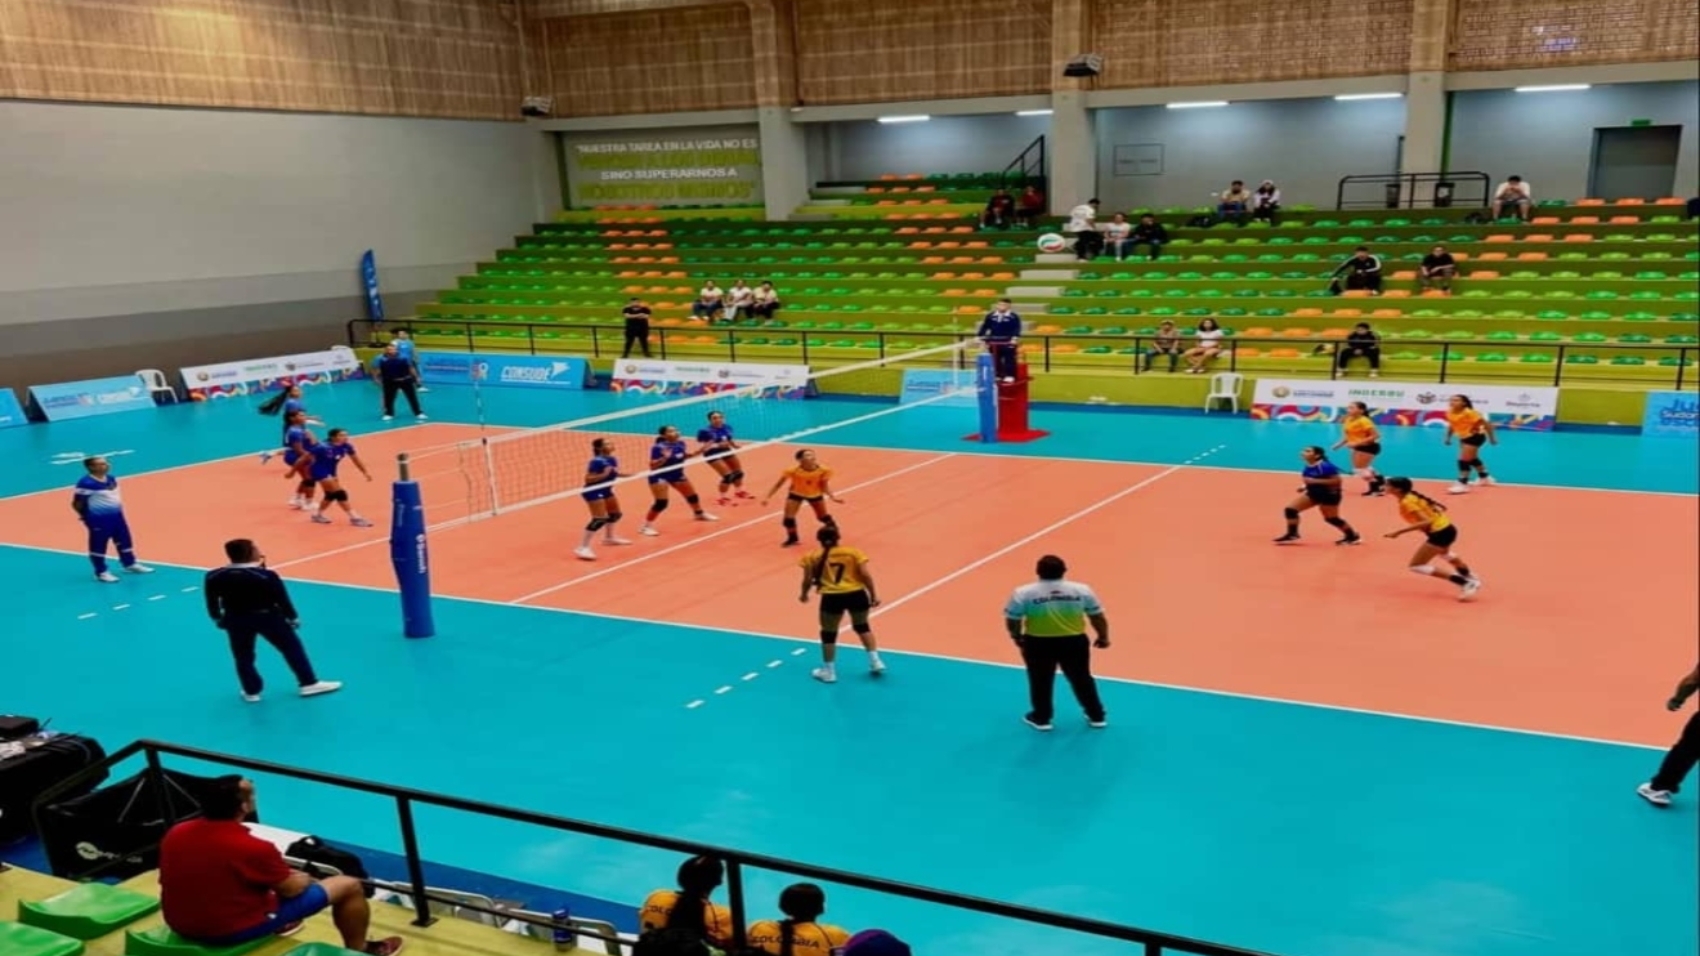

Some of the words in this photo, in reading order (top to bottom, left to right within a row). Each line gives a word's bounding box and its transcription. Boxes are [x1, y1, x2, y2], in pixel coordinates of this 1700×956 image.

[679, 141, 695, 151] LA
[696, 139, 721, 150] VIDA
[723, 139, 740, 149] NO
[742, 138, 757, 148] ES
[601, 170, 633, 180] SINO
[634, 168, 725, 180] SUPERARNOS
[727, 167, 738, 177] A
[829, 562, 845, 583] 7
